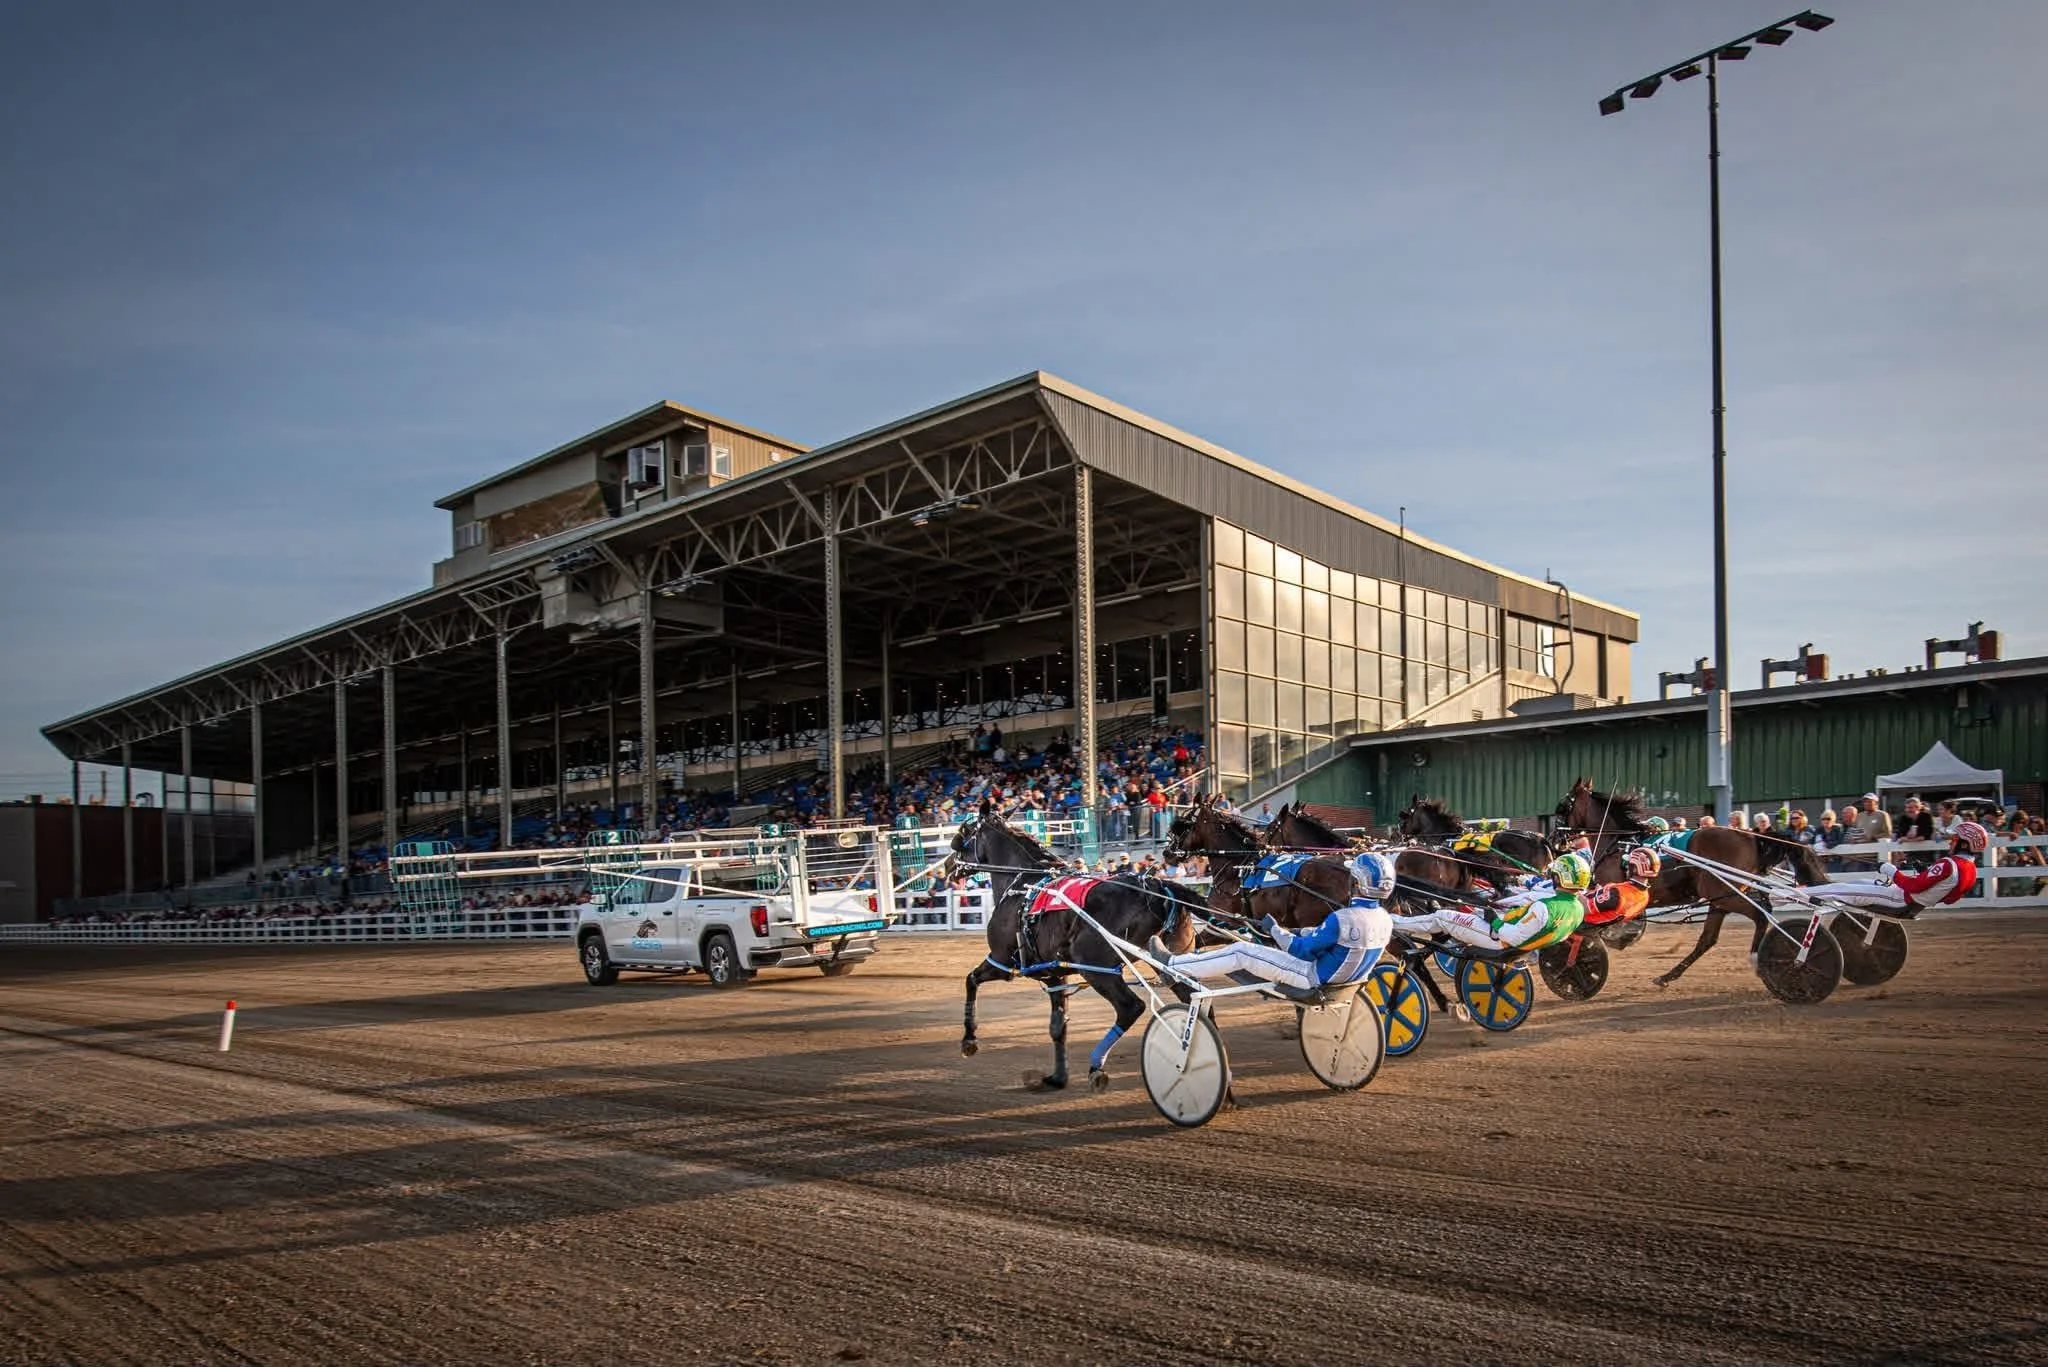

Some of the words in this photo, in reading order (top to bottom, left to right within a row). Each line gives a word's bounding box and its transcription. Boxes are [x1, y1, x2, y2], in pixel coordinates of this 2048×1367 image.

[770, 824, 779, 836] 3
[607, 831, 619, 843] 2
[809, 920, 884, 936] ONTARIORACING.COM
